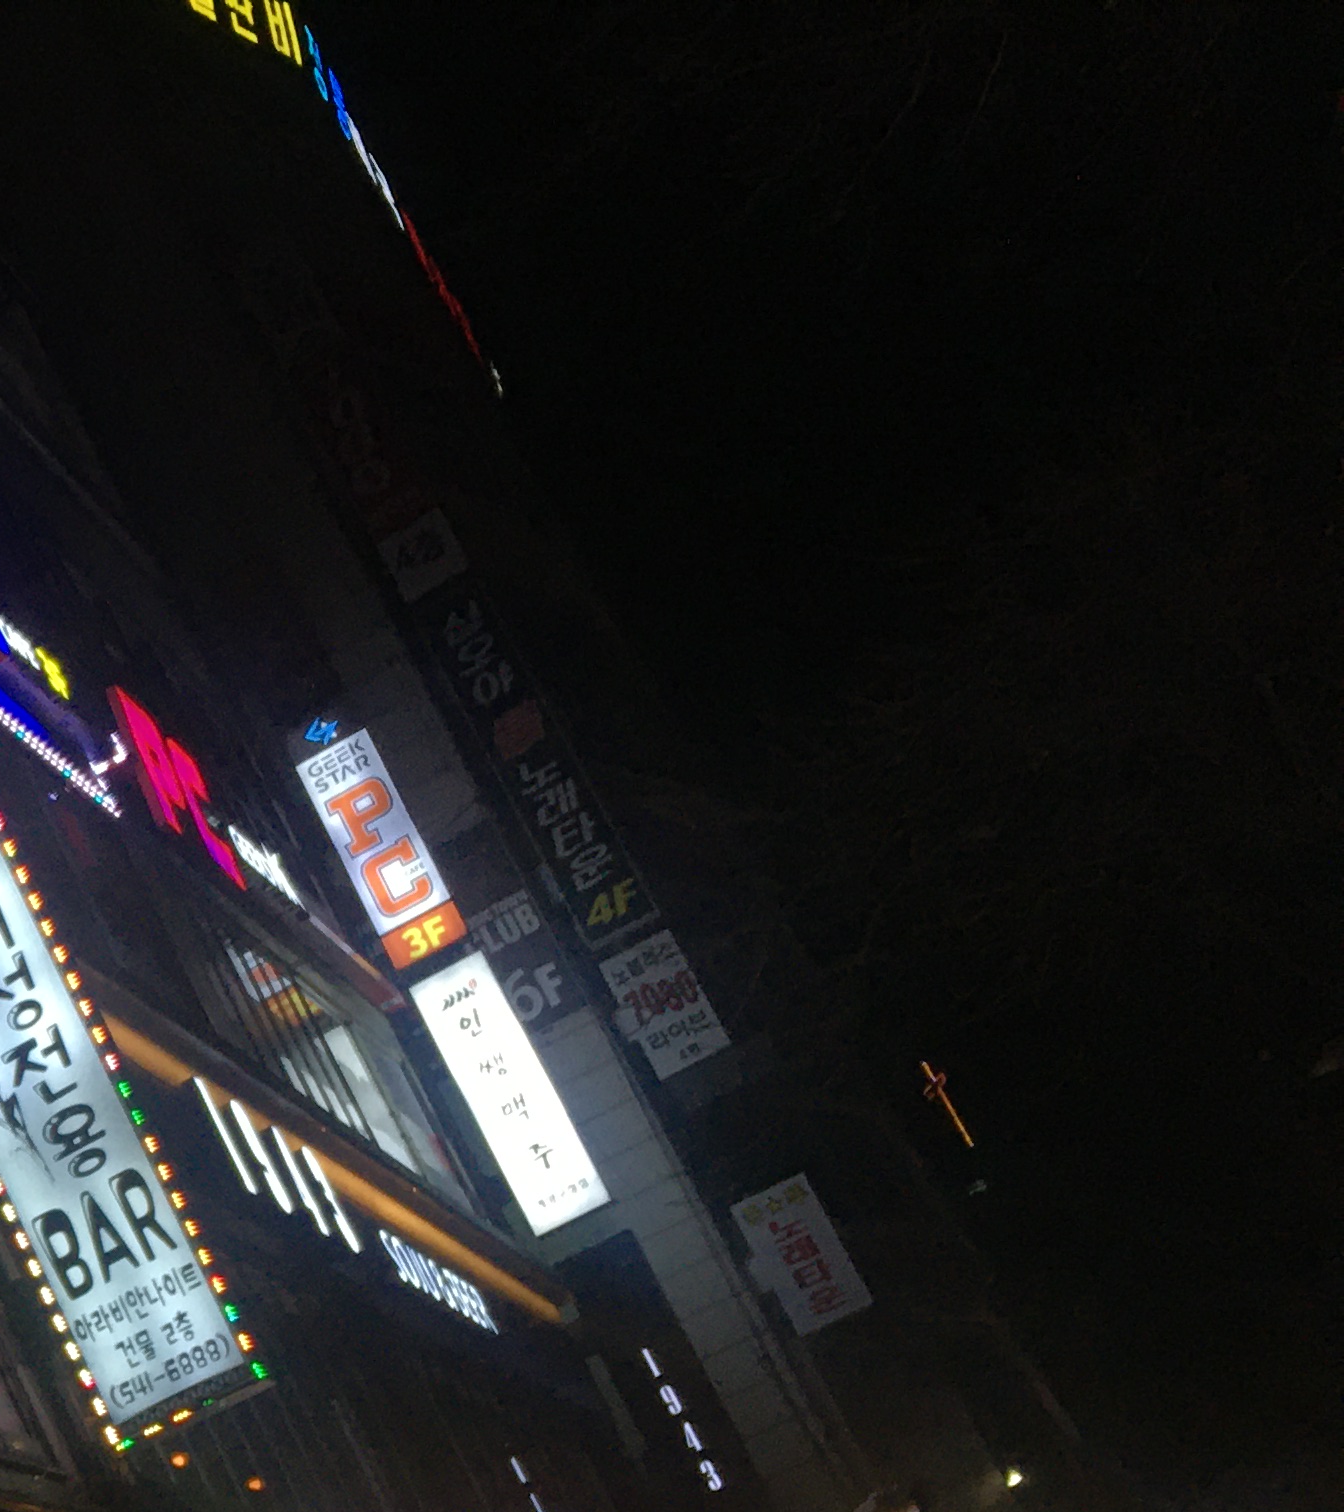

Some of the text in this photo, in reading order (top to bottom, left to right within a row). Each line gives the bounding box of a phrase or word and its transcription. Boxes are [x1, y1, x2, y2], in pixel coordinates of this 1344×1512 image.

[306, 737, 366, 779] GEEK
[315, 753, 372, 794] STAR
[326, 776, 435, 918] PC
[517, 761, 613, 892] 노래타운
[584, 879, 636, 927] 4F
[402, 914, 448, 961] 3F
[32, 1167, 179, 1301] BAR
[73, 1262, 203, 1344] 아라비안나이트
[115, 1310, 198, 1364] 건물 2층
[641, 1347, 723, 1492] 1943
